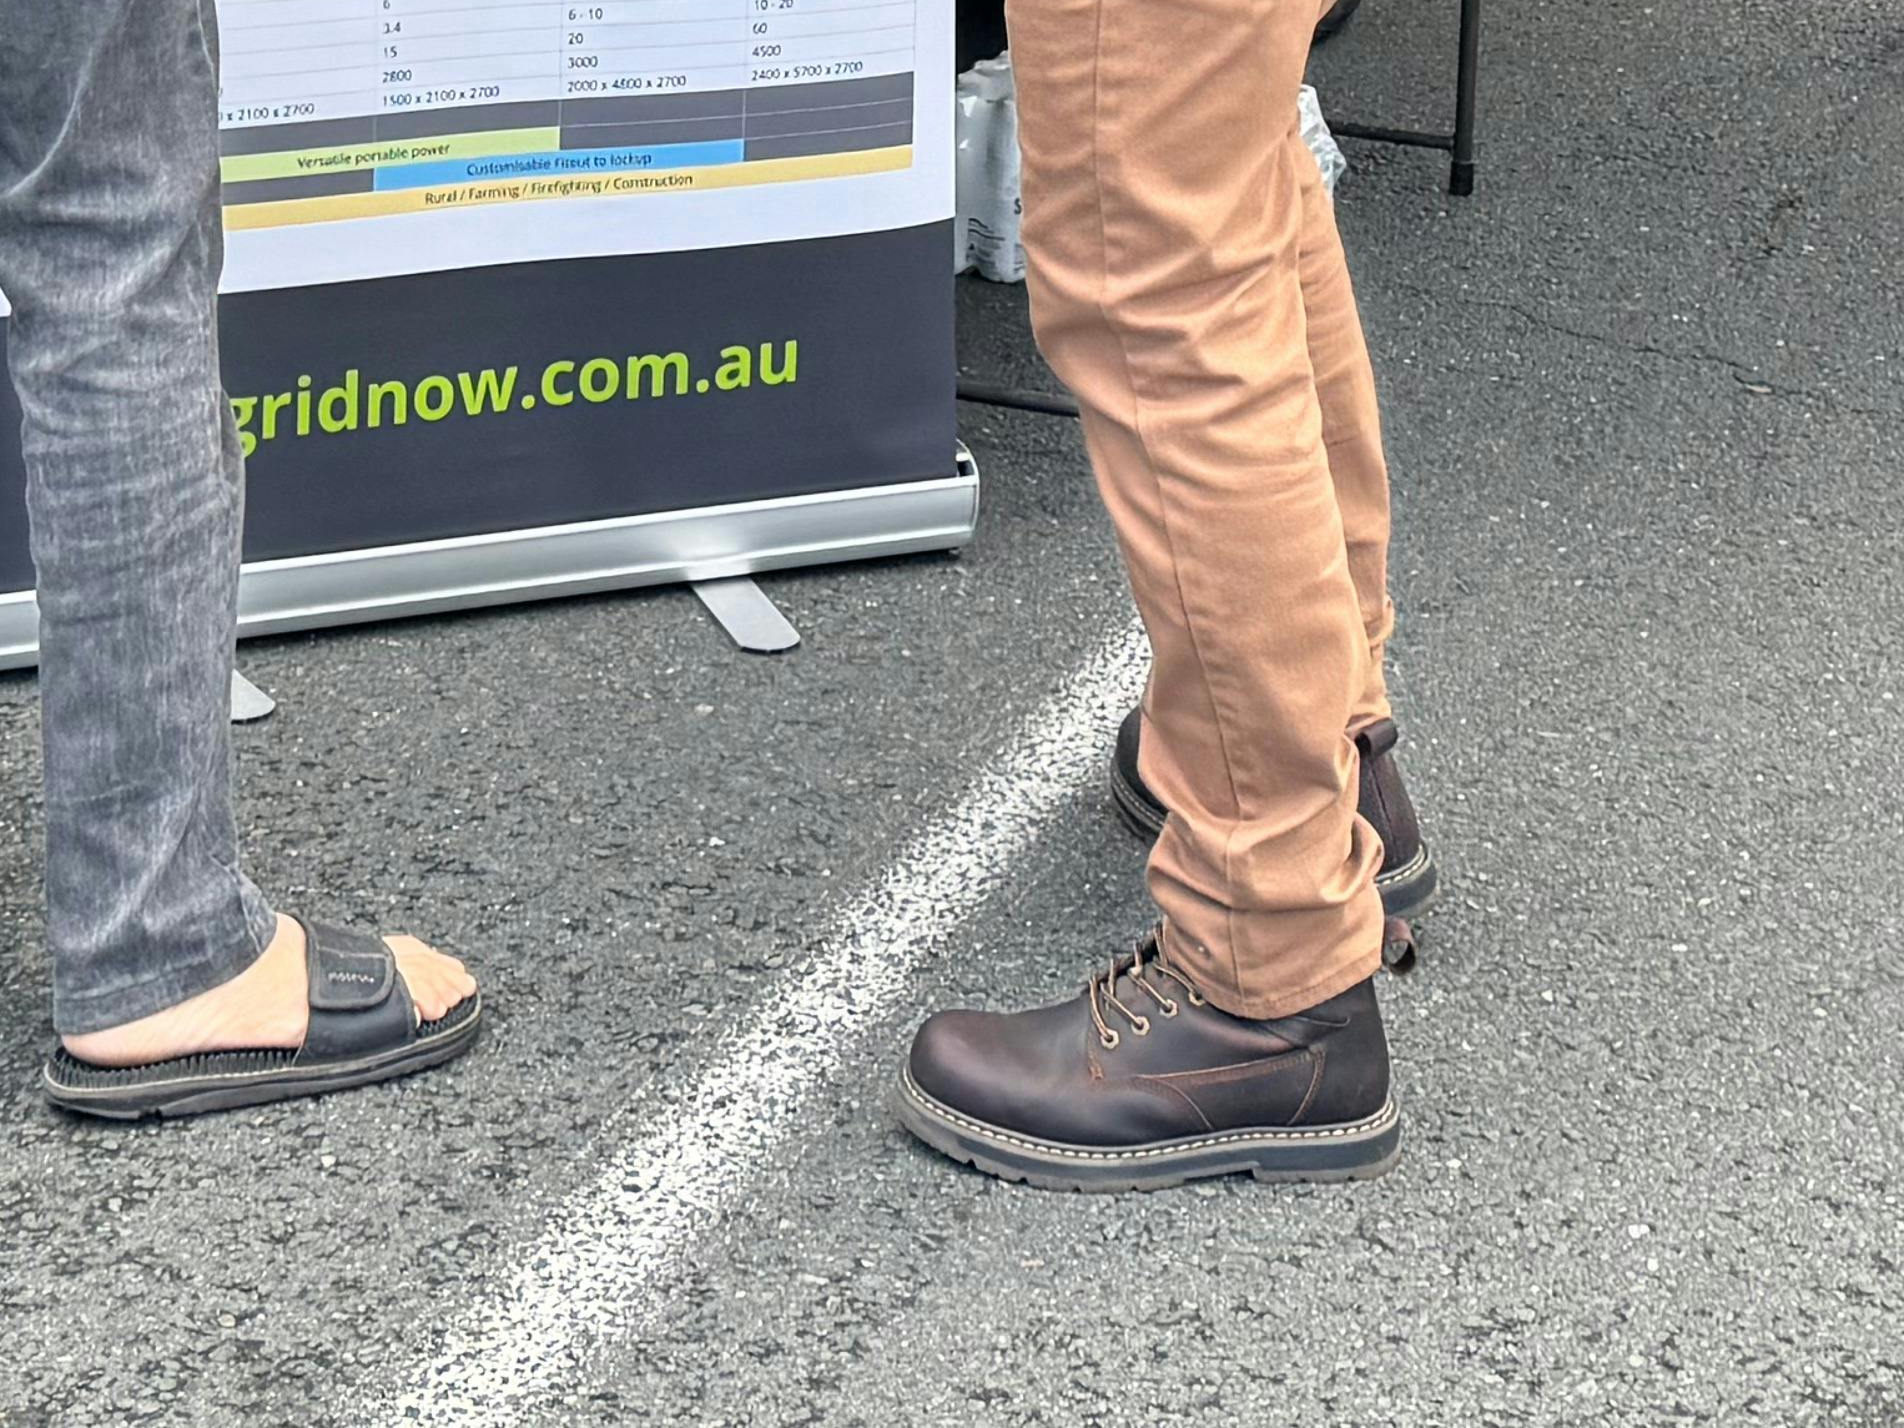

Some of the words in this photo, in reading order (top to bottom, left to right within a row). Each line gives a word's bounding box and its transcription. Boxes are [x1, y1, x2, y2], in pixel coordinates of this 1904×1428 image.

[753, 0, 769, 11] 10
[568, 9, 576, 20] 6
[588, 8, 603, 20] 10
[568, 32, 583, 44] 20
[383, 45, 397, 58] 15
[567, 55, 598, 69] 3000
[410, 144, 450, 159] power
[593, 152, 606, 167] to
[425, 189, 457, 204] Rural
[230, 340, 799, 458] gridnow.com.au
